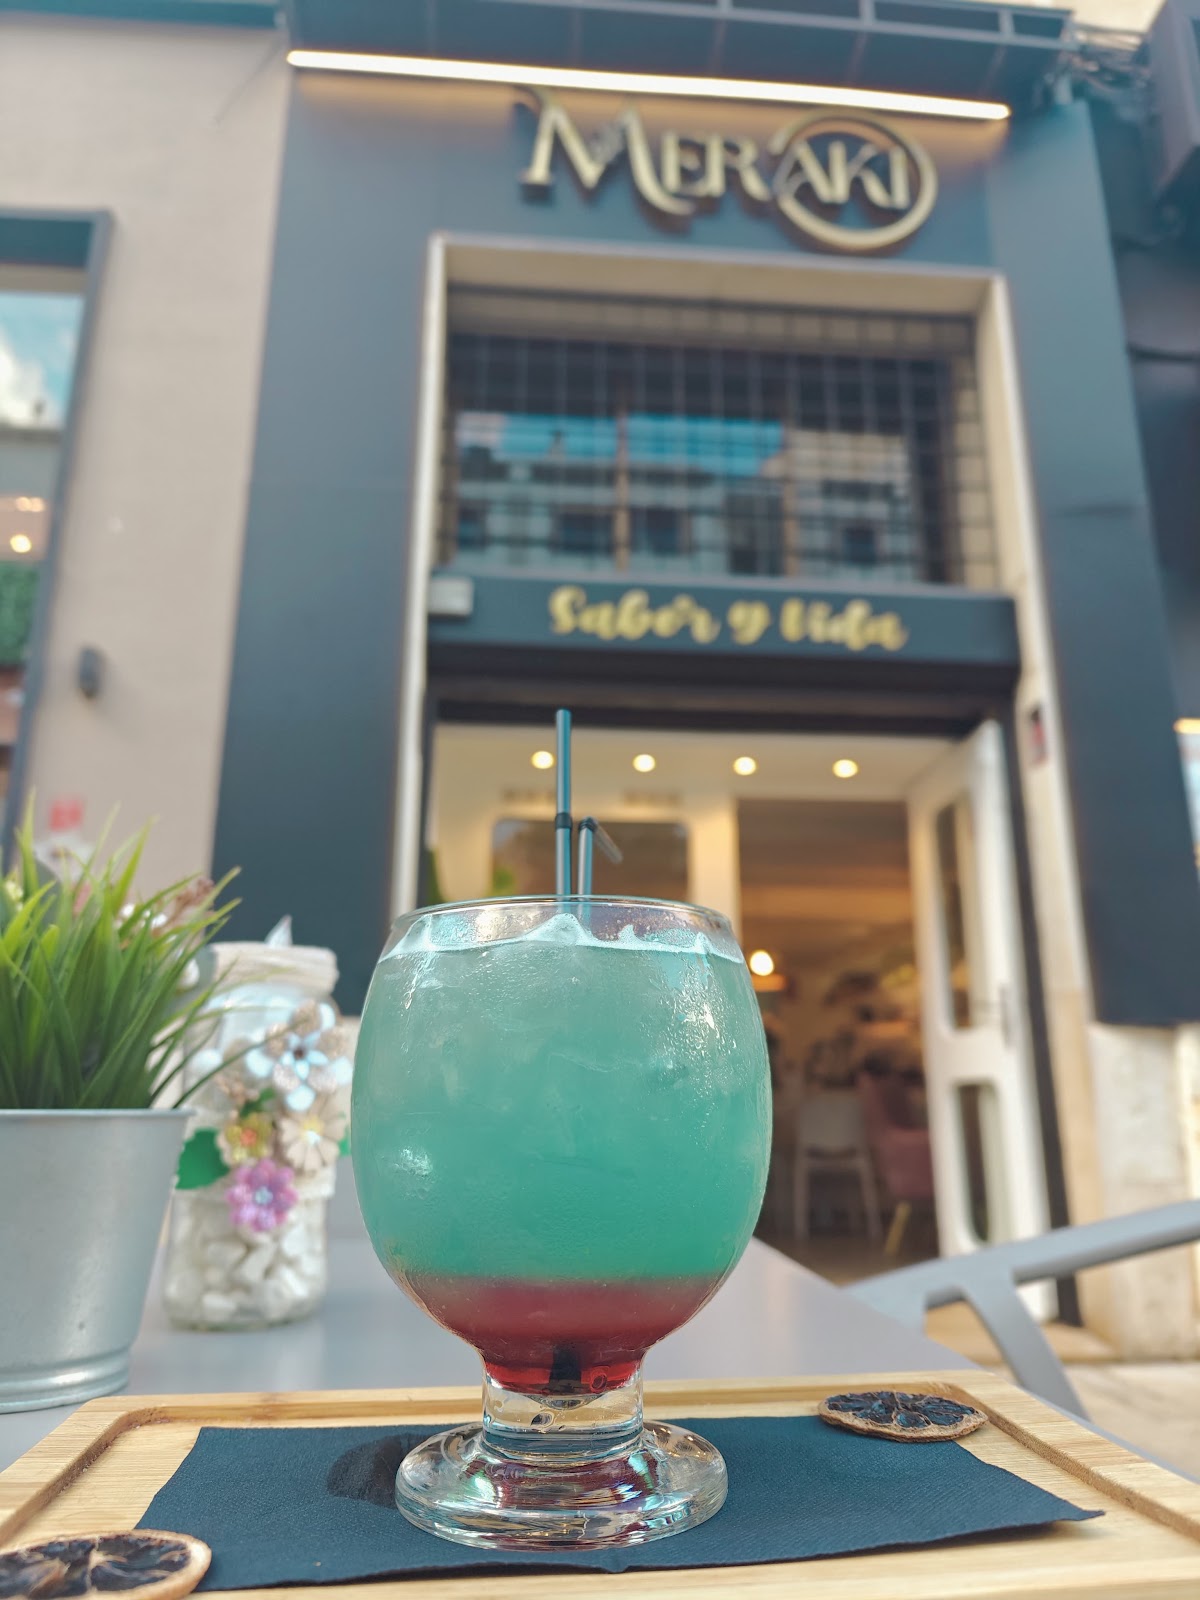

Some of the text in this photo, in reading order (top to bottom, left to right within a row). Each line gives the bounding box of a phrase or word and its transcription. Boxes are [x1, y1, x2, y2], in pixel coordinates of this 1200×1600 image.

[513, 86, 938, 249] MERAKI
[549, 585, 908, 651] Sabor y Vida
